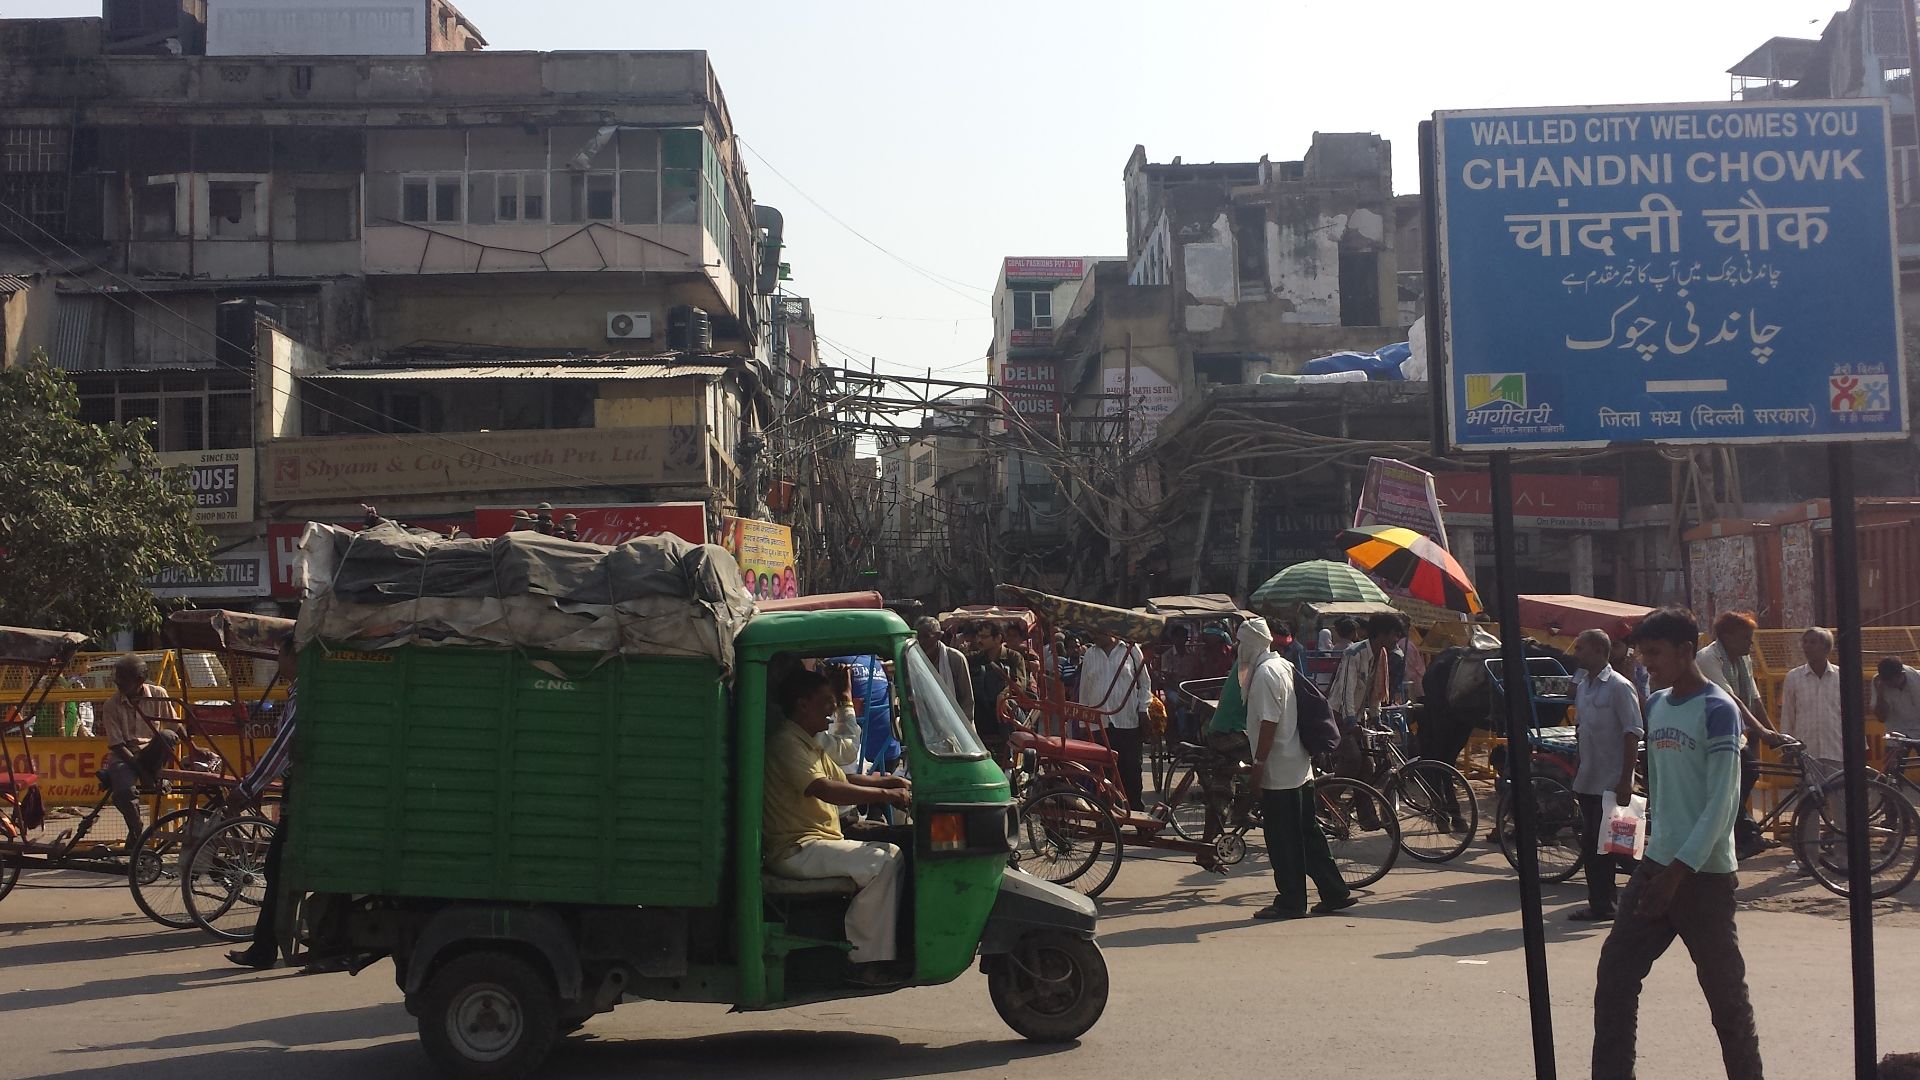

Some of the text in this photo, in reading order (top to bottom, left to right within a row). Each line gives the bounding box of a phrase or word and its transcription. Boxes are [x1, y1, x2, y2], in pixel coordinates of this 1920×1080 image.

[1470, 111, 1857, 146] WALLED CITY WELCOMES YOU
[1462, 149, 1865, 190] CHANDNI CHOWK
[1504, 187, 1830, 257] चांदनी चौक
[1566, 295, 1659, 362] چوک
[1005, 366, 1055, 381] DELHI
[1466, 403, 1552, 424] भागीदारी
[1598, 406, 1641, 428] जिला
[1649, 410, 1682, 427] मध्य
[200, 454, 224, 464] SINCE
[305, 456, 379, 481] Shyam
[386, 455, 405, 472] &
[459, 453, 484, 473] Of
[492, 449, 554, 466] North
[562, 448, 602, 464] Pvt.
[610, 444, 652, 462] Ltd.
[189, 468, 235, 490] OUSE
[196, 512, 216, 520] SHOP
[1536, 517, 1549, 527] Om
[1551, 517, 1579, 528] Prakash
[534, 679, 576, 690] CNG
